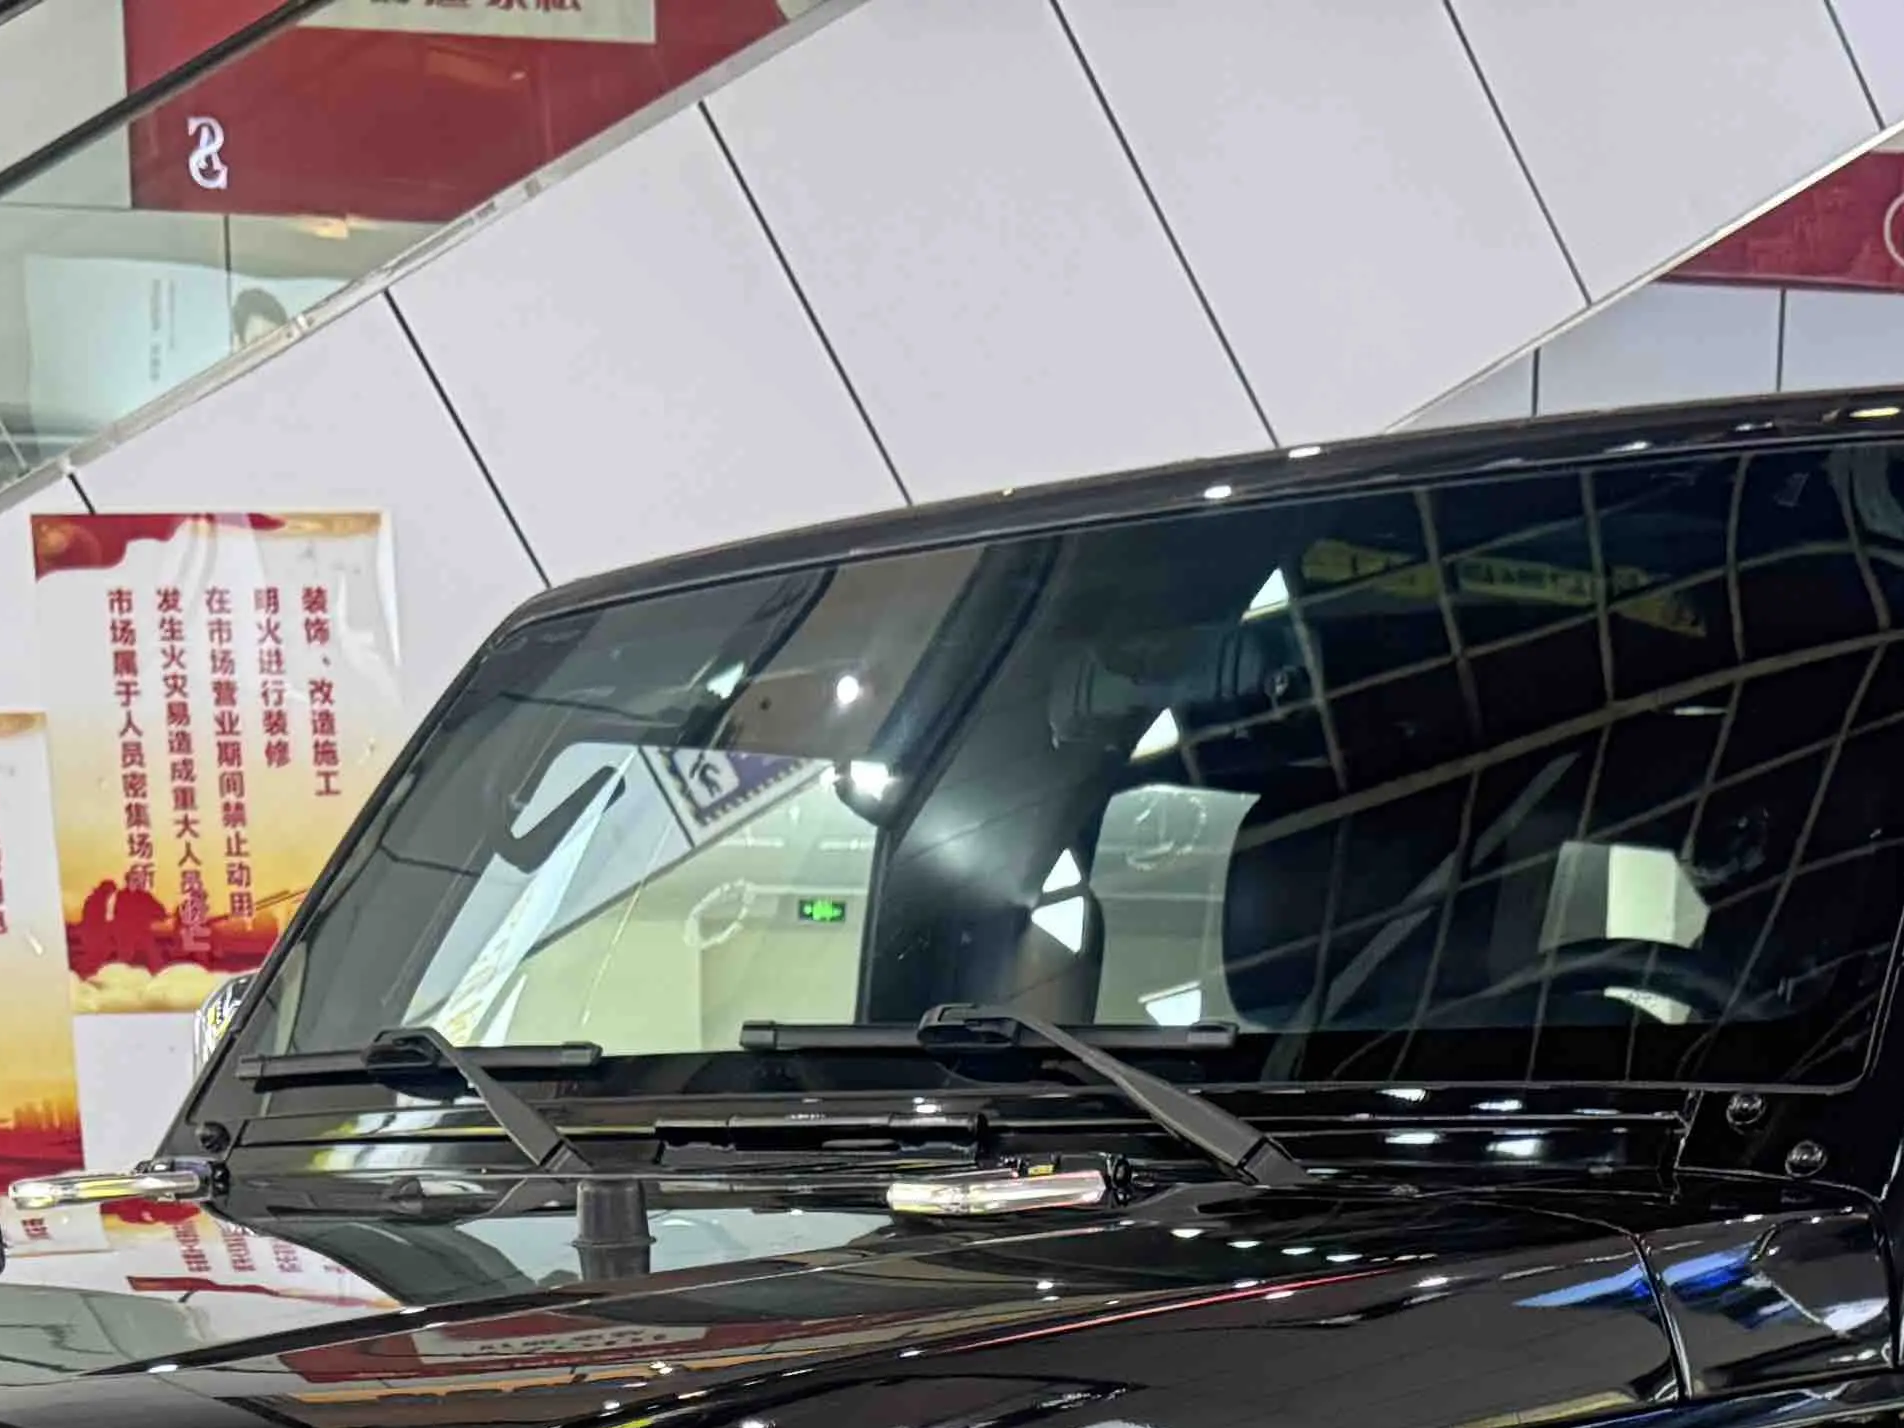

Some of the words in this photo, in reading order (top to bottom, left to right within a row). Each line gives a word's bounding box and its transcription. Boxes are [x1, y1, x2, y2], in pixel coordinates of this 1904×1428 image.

[254, 587, 292, 769] 明火进行装修
[302, 587, 341, 797] 装饰、改造施工
